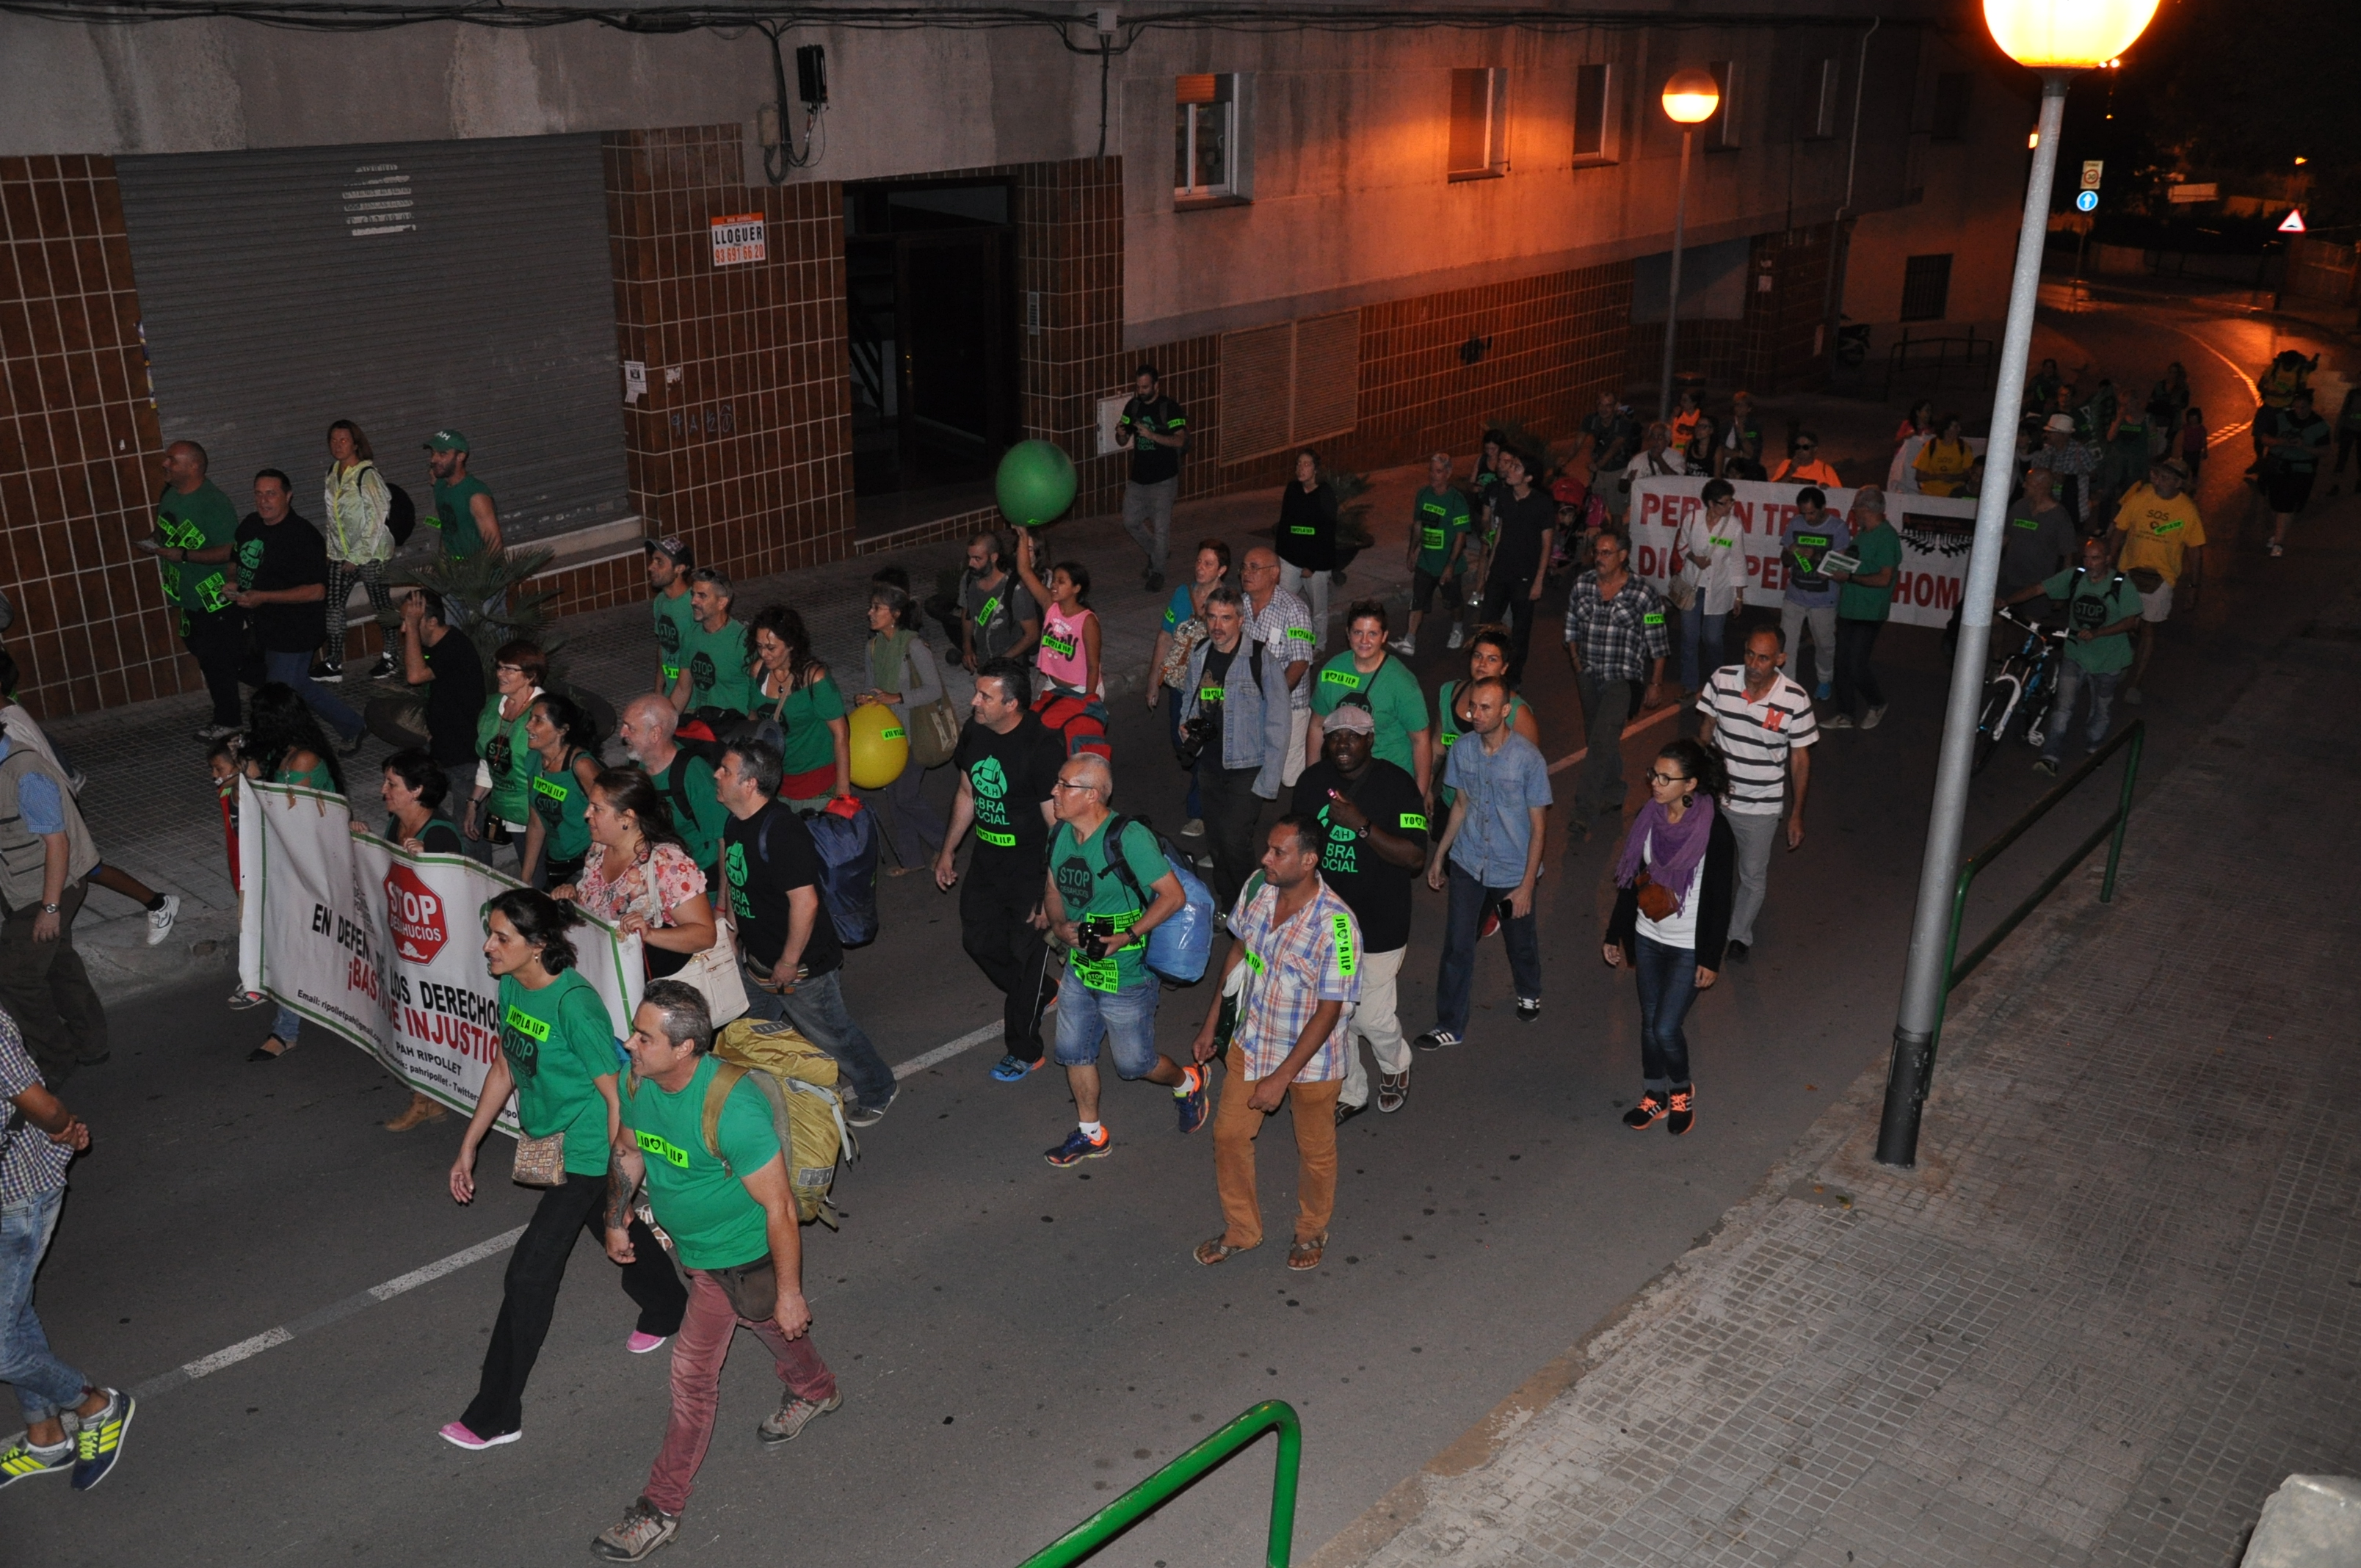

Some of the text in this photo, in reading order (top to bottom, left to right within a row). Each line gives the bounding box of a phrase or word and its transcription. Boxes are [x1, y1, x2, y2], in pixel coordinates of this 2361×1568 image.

[715, 226, 762, 244] LLOGUER
[715, 244, 763, 264] 93 691 66 20
[2146, 509, 2169, 521] SOS
[2075, 601, 2104, 617] STOP
[692, 660, 713, 675] STOP
[1345, 676, 1356, 685] ILP
[1761, 707, 1785, 732] M
[489, 743, 509, 758] STOP
[553, 786, 565, 798] ILP
[537, 797, 559, 813] STOP
[1404, 816, 1415, 825] YO
[990, 833, 998, 842] LA
[999, 835, 1012, 843] ILP
[1326, 842, 1356, 860] BRA
[1321, 857, 1358, 873] OCIAL
[1059, 866, 1090, 888] STOP
[388, 881, 438, 925] STOP
[391, 913, 442, 942] DESAHUCIOS
[1335, 918, 1346, 929] JO
[1341, 956, 1351, 970] ILP
[312, 902, 333, 937] EN
[390, 965, 411, 1005] LOS
[1251, 957, 1261, 970] ILP
[521, 1017, 530, 1029] LA
[532, 1022, 545, 1035] ILP
[297, 989, 320, 1006] Email:
[410, 1065, 449, 1088] pahripollet
[452, 1082, 479, 1102] Twitter:
[504, 1028, 534, 1061] STOP
[396, 1042, 462, 1077] PAH RIPOLLET
[670, 1149, 683, 1163] ILP
